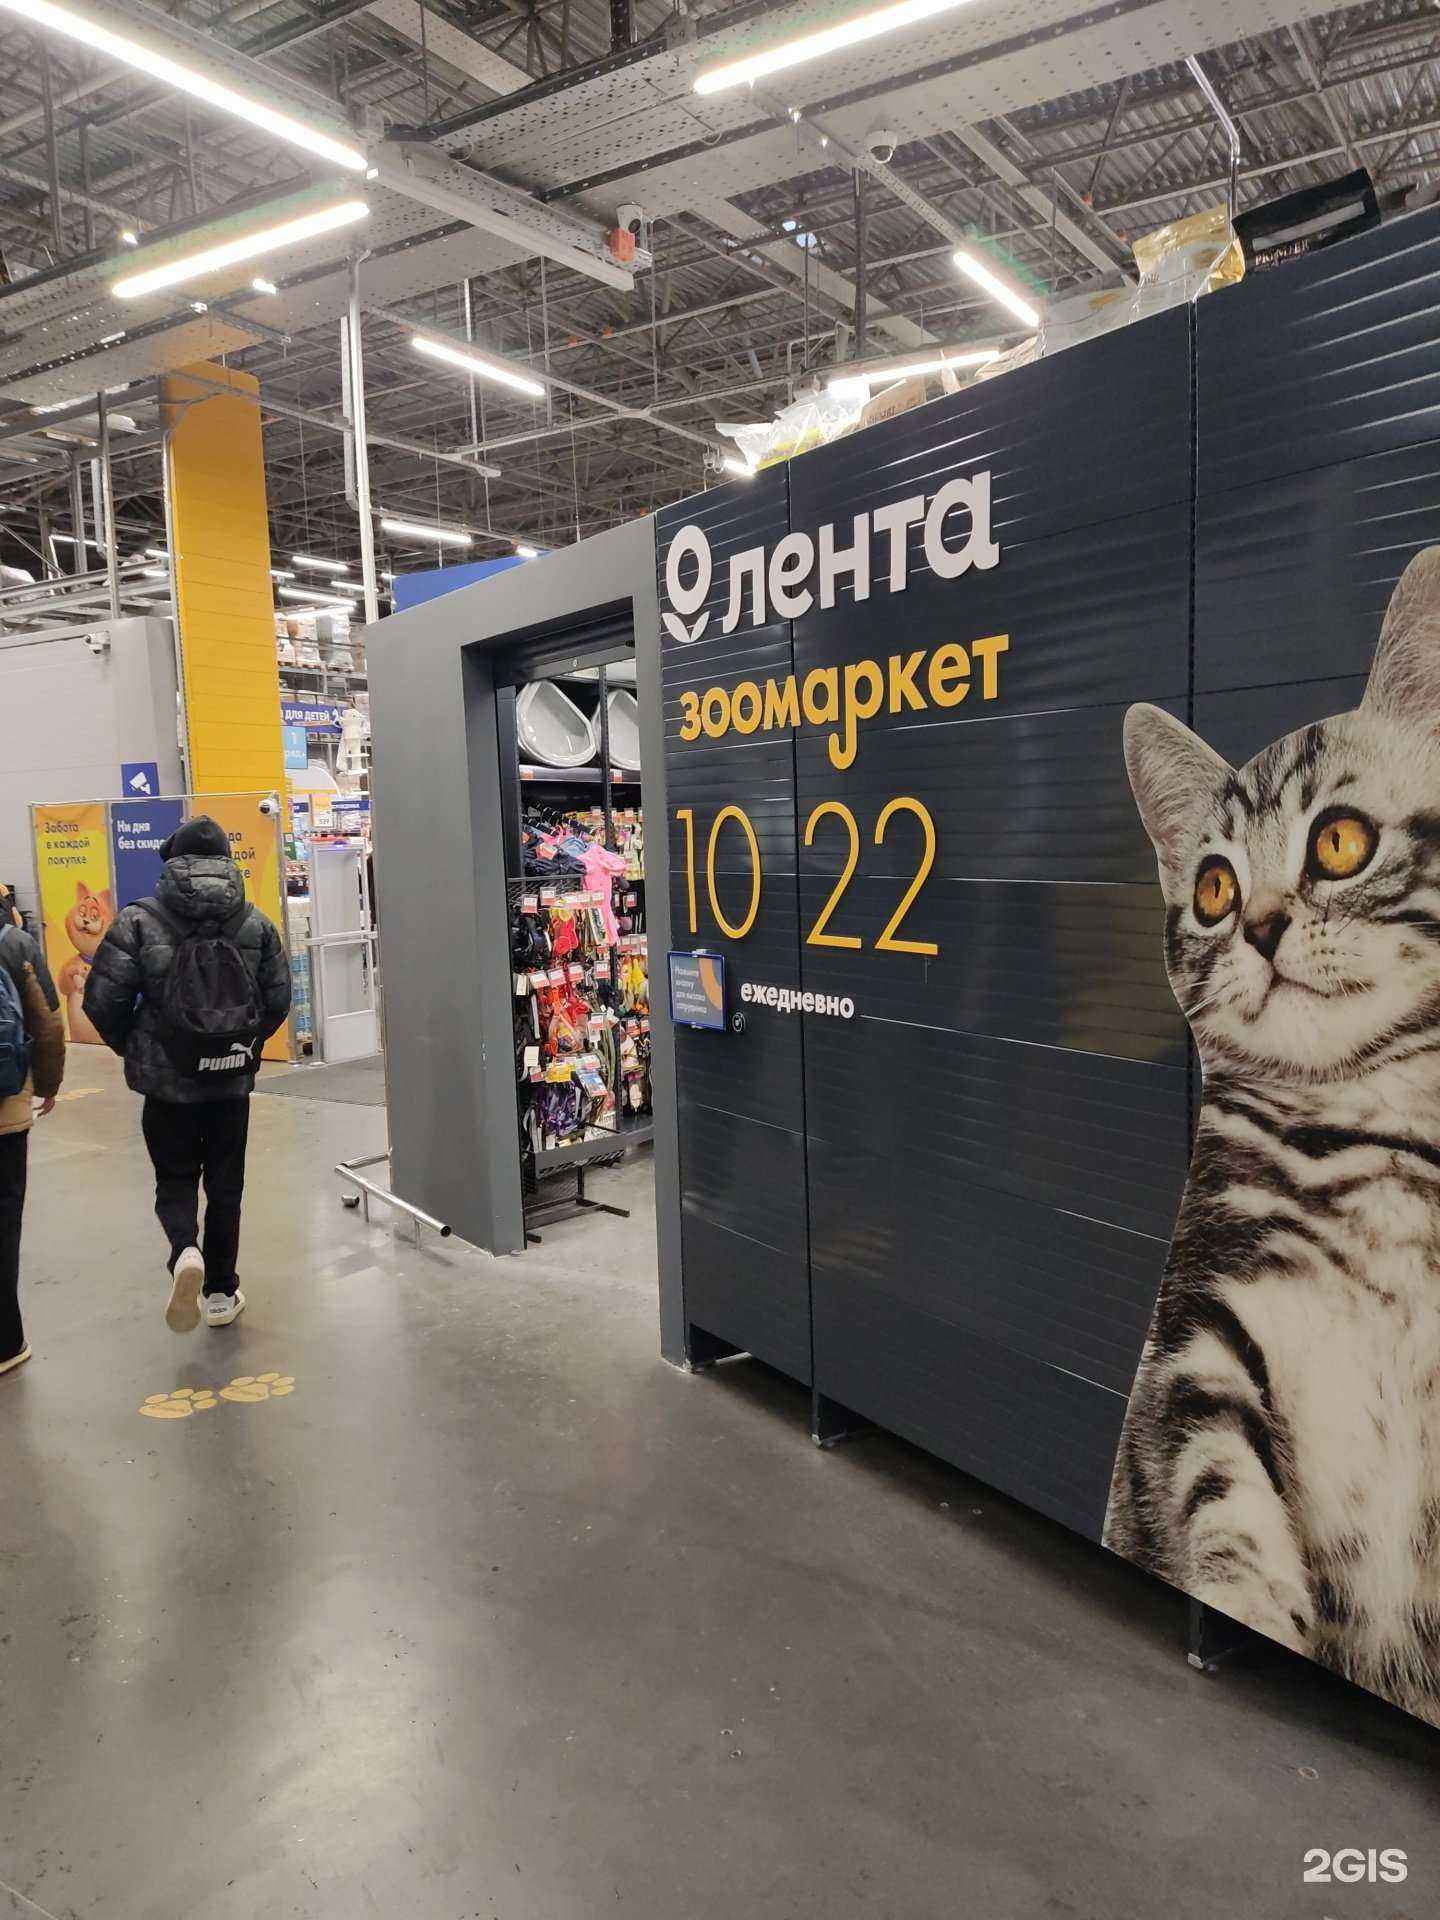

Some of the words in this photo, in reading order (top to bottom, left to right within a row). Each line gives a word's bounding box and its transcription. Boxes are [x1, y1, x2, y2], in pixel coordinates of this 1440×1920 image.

[723, 470, 1000, 633] лента
[679, 634, 1009, 770] зоомаркет
[285, 709, 304, 720] ДЛЯ
[44, 820, 79, 833] Забота
[117, 819, 131, 832] Ни
[132, 822, 151, 834] дня
[54, 837, 91, 850] каждой
[118, 836, 135, 849] без
[47, 855, 87, 868] покупке
[676, 805, 761, 939] 10
[804, 797, 938, 955] 22
[741, 983, 854, 1018] ежедневно
[199, 1053, 246, 1071] PUMA
